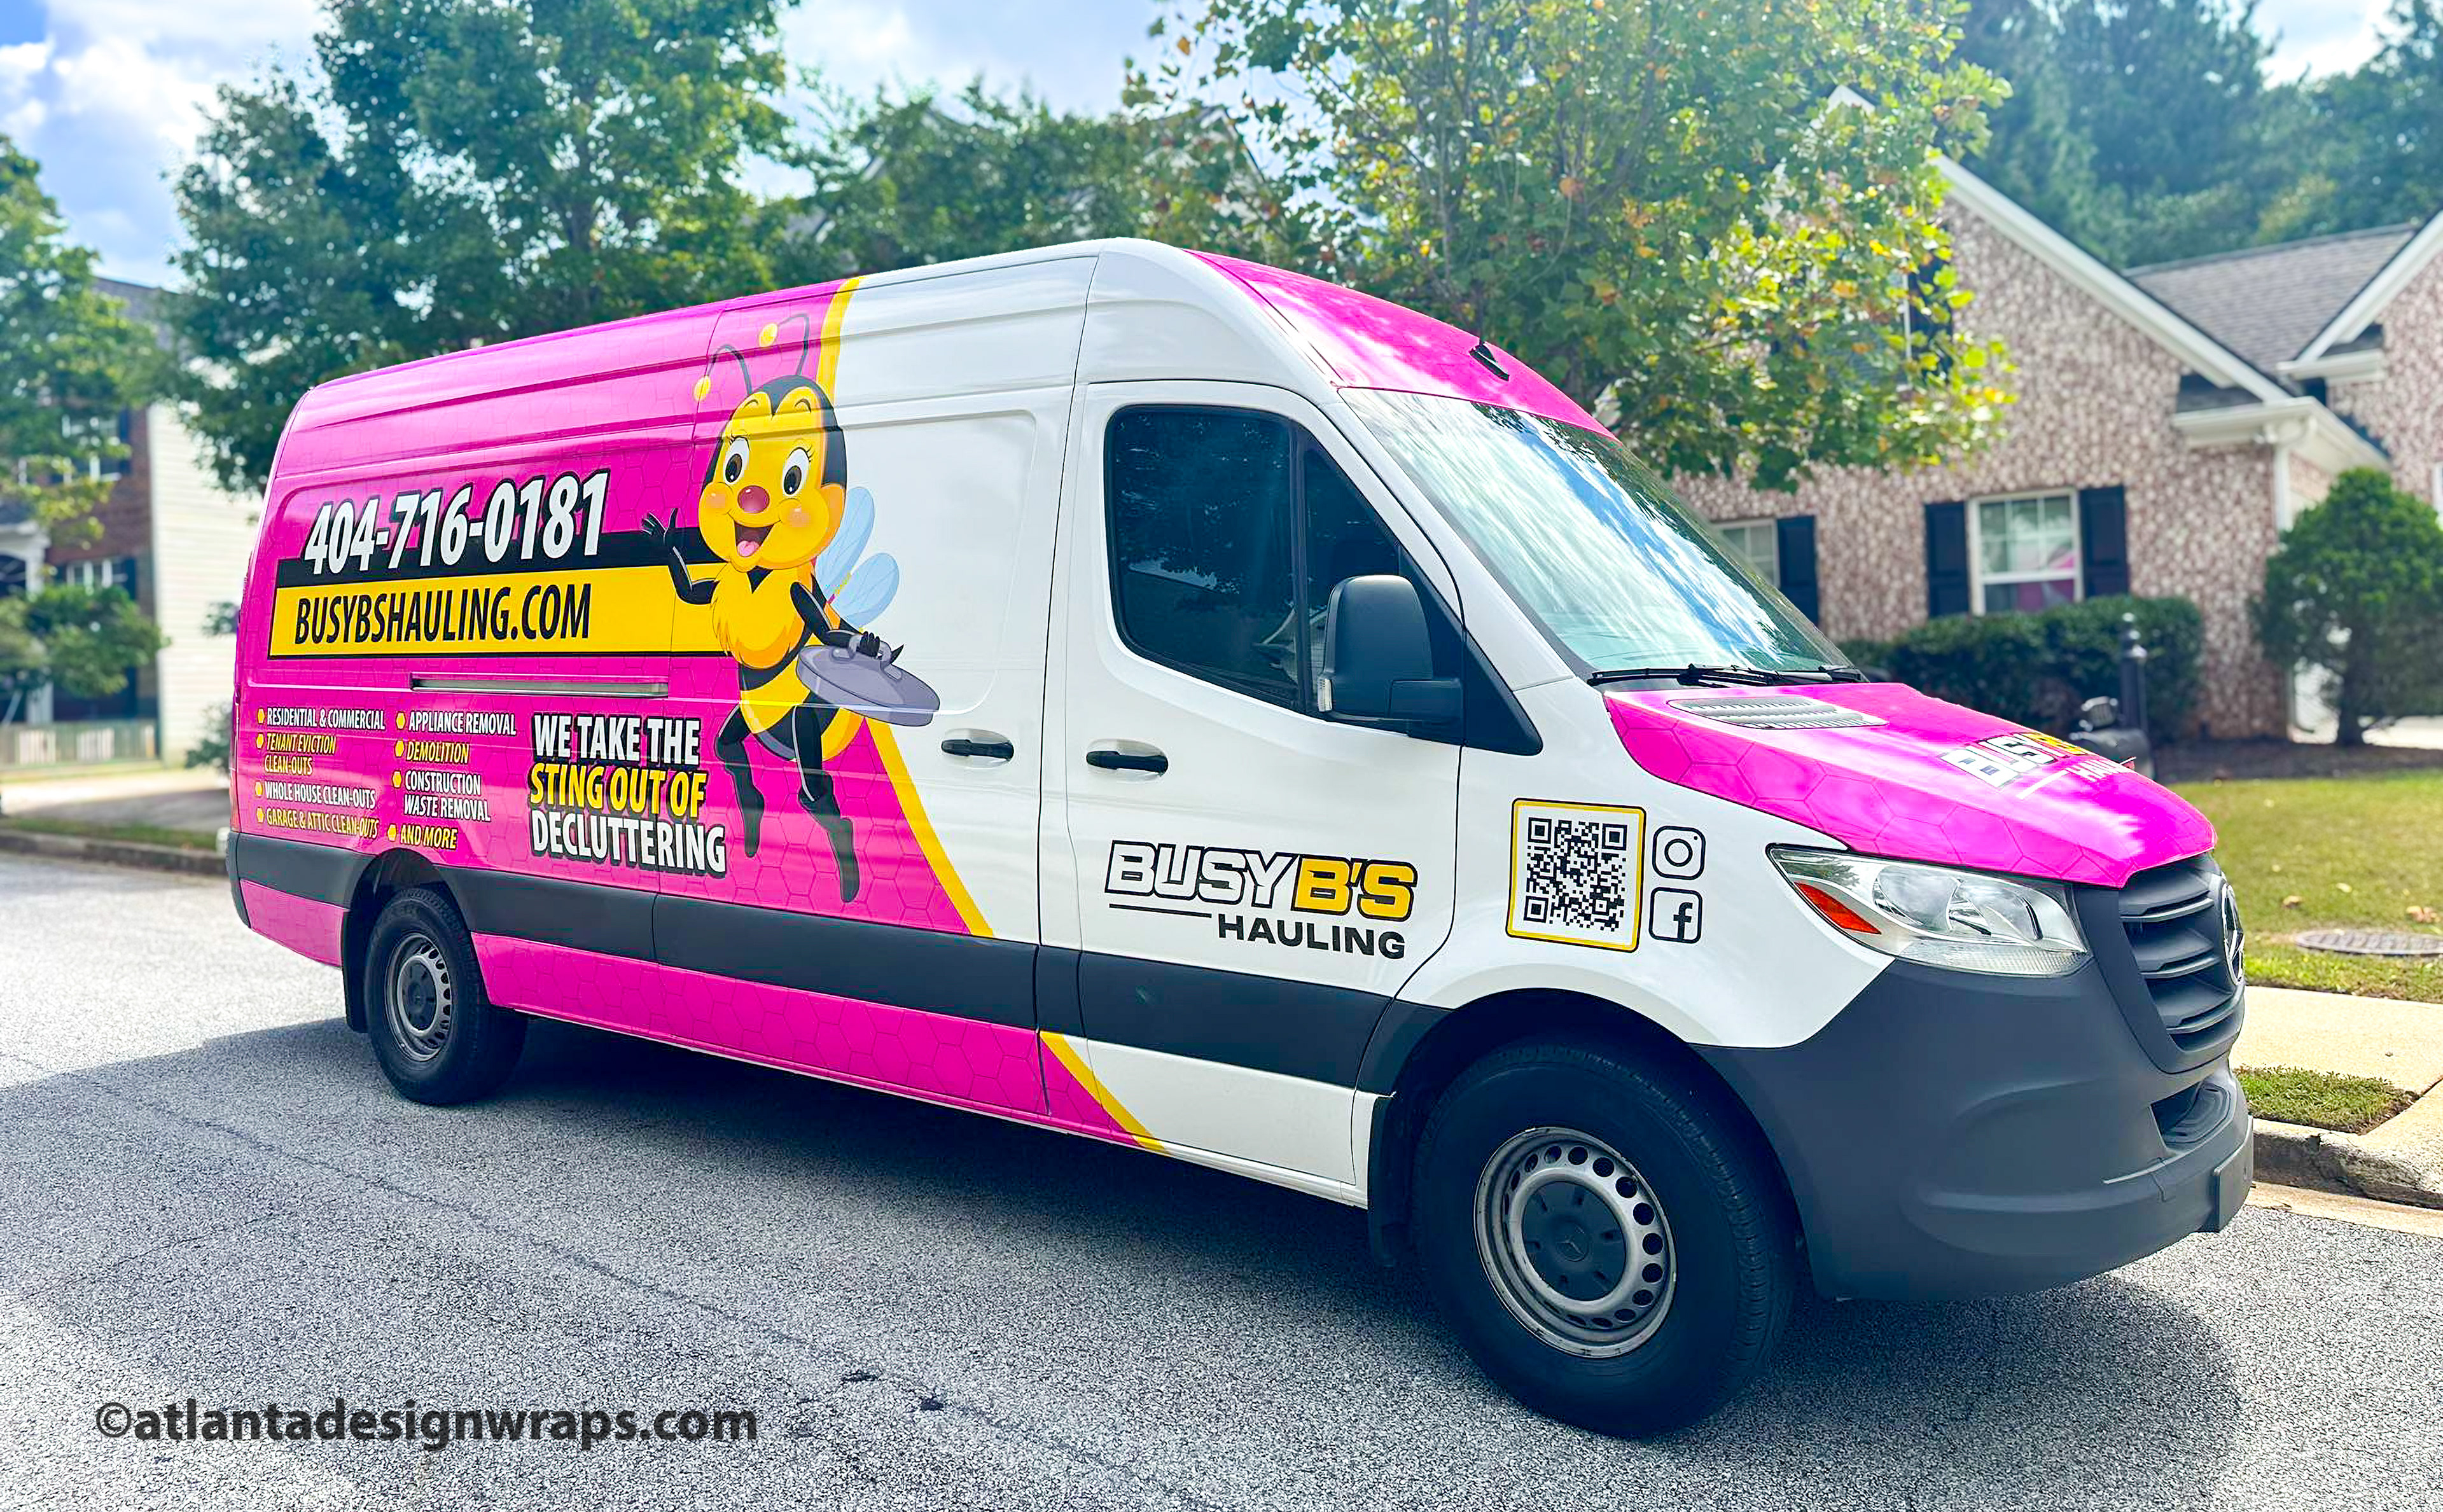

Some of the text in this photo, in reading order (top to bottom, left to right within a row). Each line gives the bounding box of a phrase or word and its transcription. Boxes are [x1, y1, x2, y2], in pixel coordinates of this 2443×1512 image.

[303, 470, 610, 575] 404-716-0181
[294, 583, 592, 645] BUSYBSHAULING.COM
[267, 707, 386, 730] RESIDENTIAL & COMMERCIAL
[408, 711, 517, 735] APPLIANCE REMOVAL
[267, 733, 337, 755] TENANT EVICTION
[407, 740, 470, 763] DEMOLITION
[533, 714, 700, 765] WE TAKE THE
[264, 754, 313, 775] CLEAN-OUTS
[265, 780, 376, 809] WHOLE HOUSE CLEAN-OUTS
[405, 770, 482, 796] CONSTRUCTION
[530, 762, 707, 818] STING OUT OF
[404, 794, 491, 822] WASTE REMOVAL
[266, 808, 380, 839] GARAGE & ATTIC CLEAN-OUTS
[400, 824, 458, 849] AND MORE
[531, 809, 727, 873] DECLUTTERING
[1218, 913, 1405, 960] HAULING
